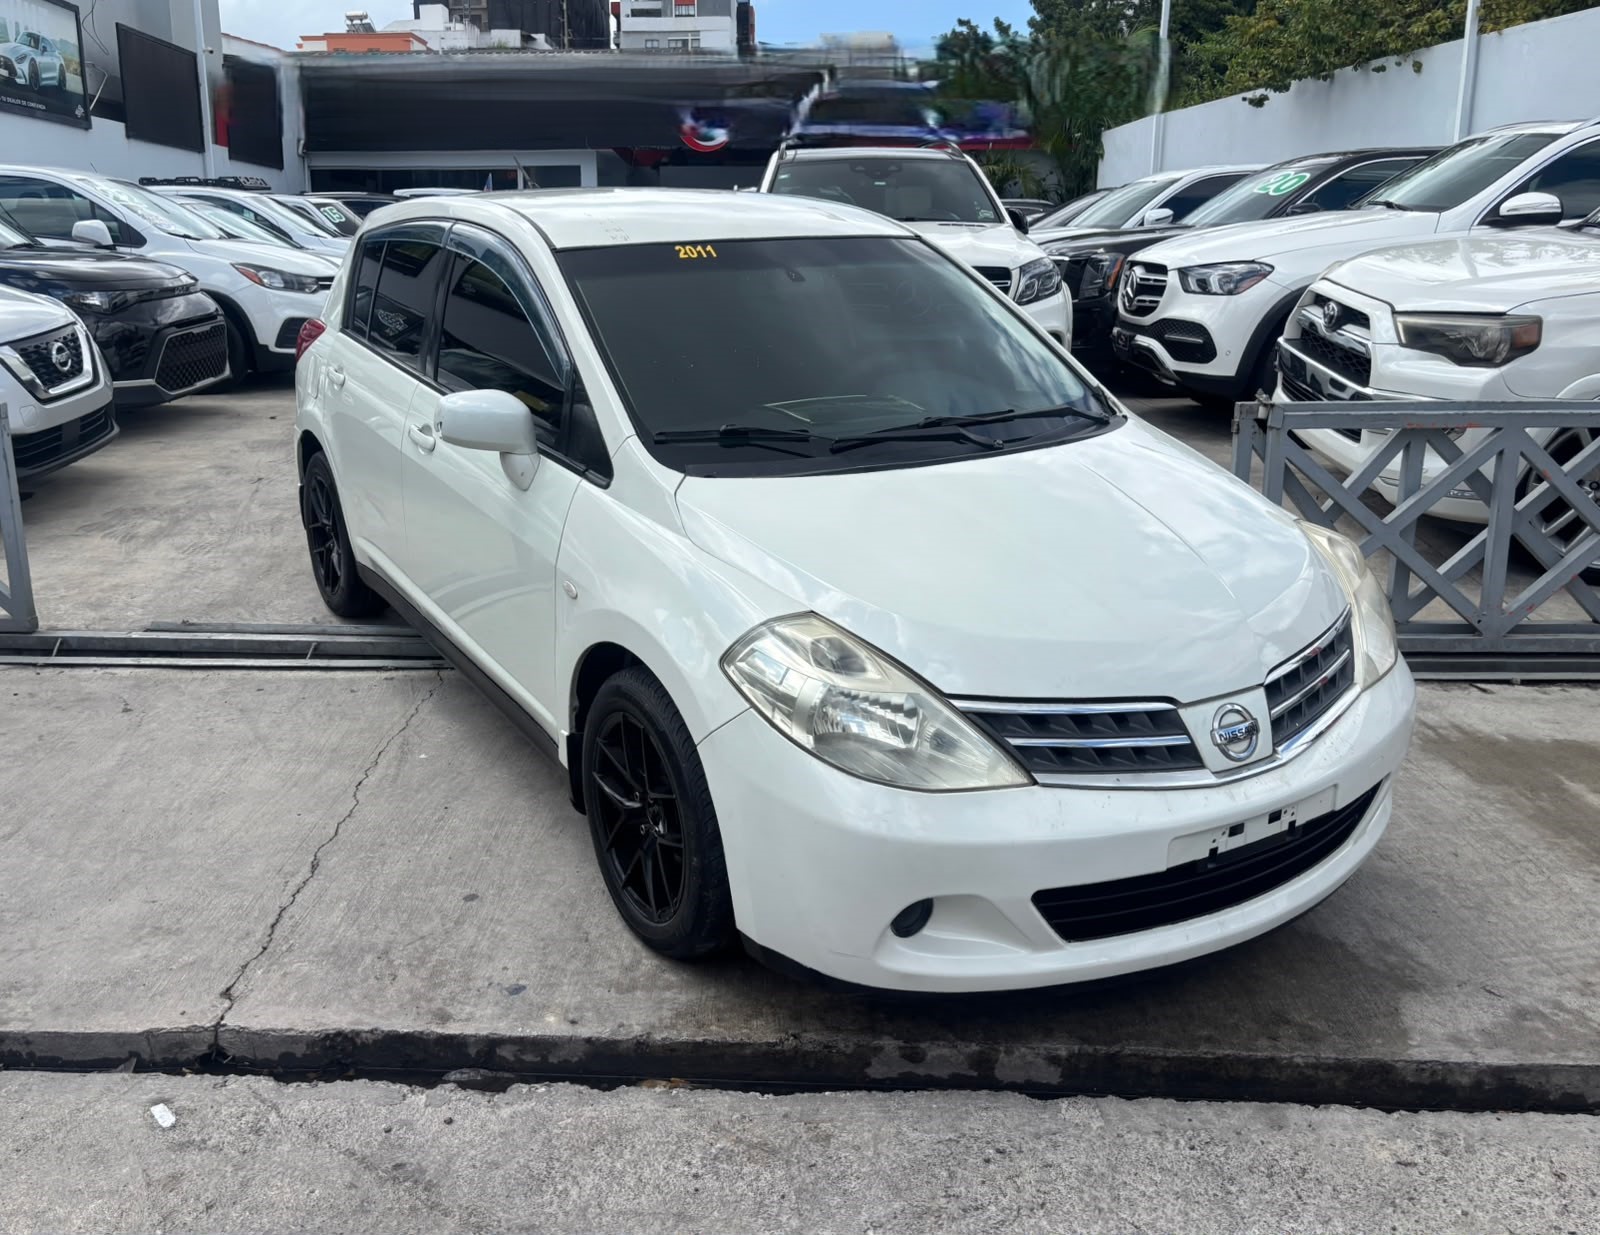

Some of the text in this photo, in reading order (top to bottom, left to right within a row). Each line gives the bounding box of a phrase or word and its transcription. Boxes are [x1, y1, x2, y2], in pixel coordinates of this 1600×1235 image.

[1254, 171, 1310, 196] 20
[674, 244, 717, 259] 2011
[1218, 720, 1258, 742] NISSAN
